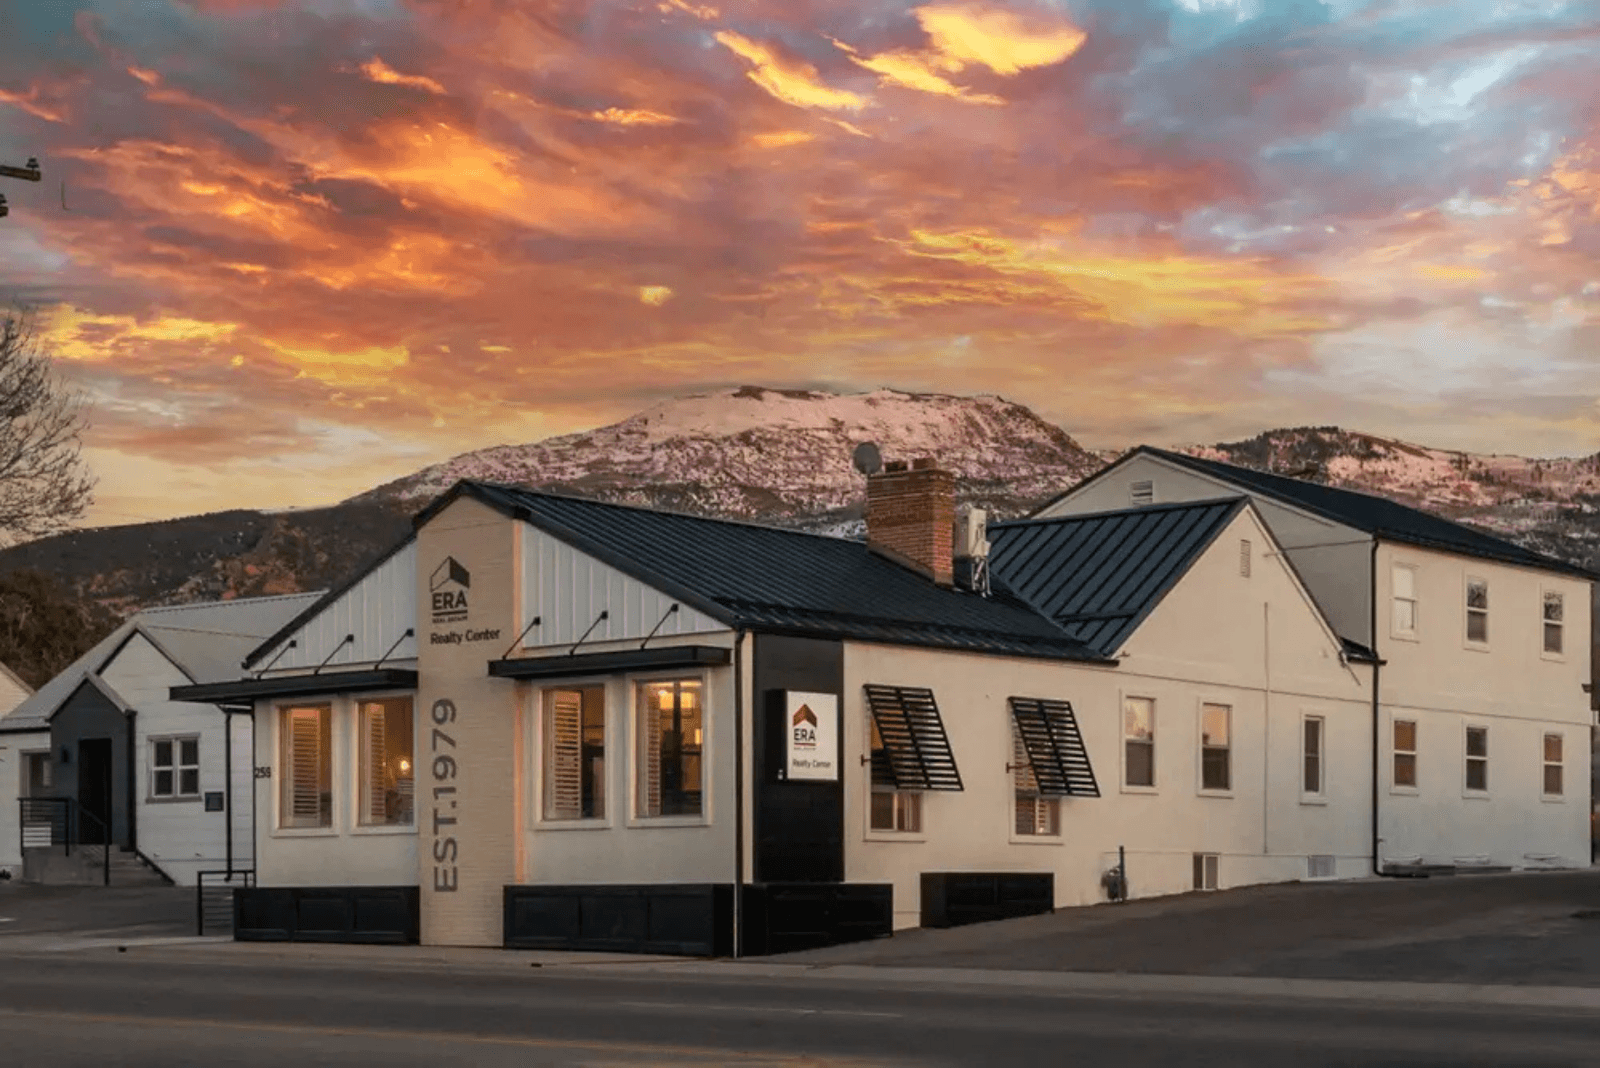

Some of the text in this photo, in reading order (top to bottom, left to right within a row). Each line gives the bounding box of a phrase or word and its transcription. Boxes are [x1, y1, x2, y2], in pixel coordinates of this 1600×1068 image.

[432, 590, 468, 610] ERA
[430, 628, 500, 645] Realty Center
[793, 728, 816, 741] ERA
[432, 698, 458, 892] EST.1979
